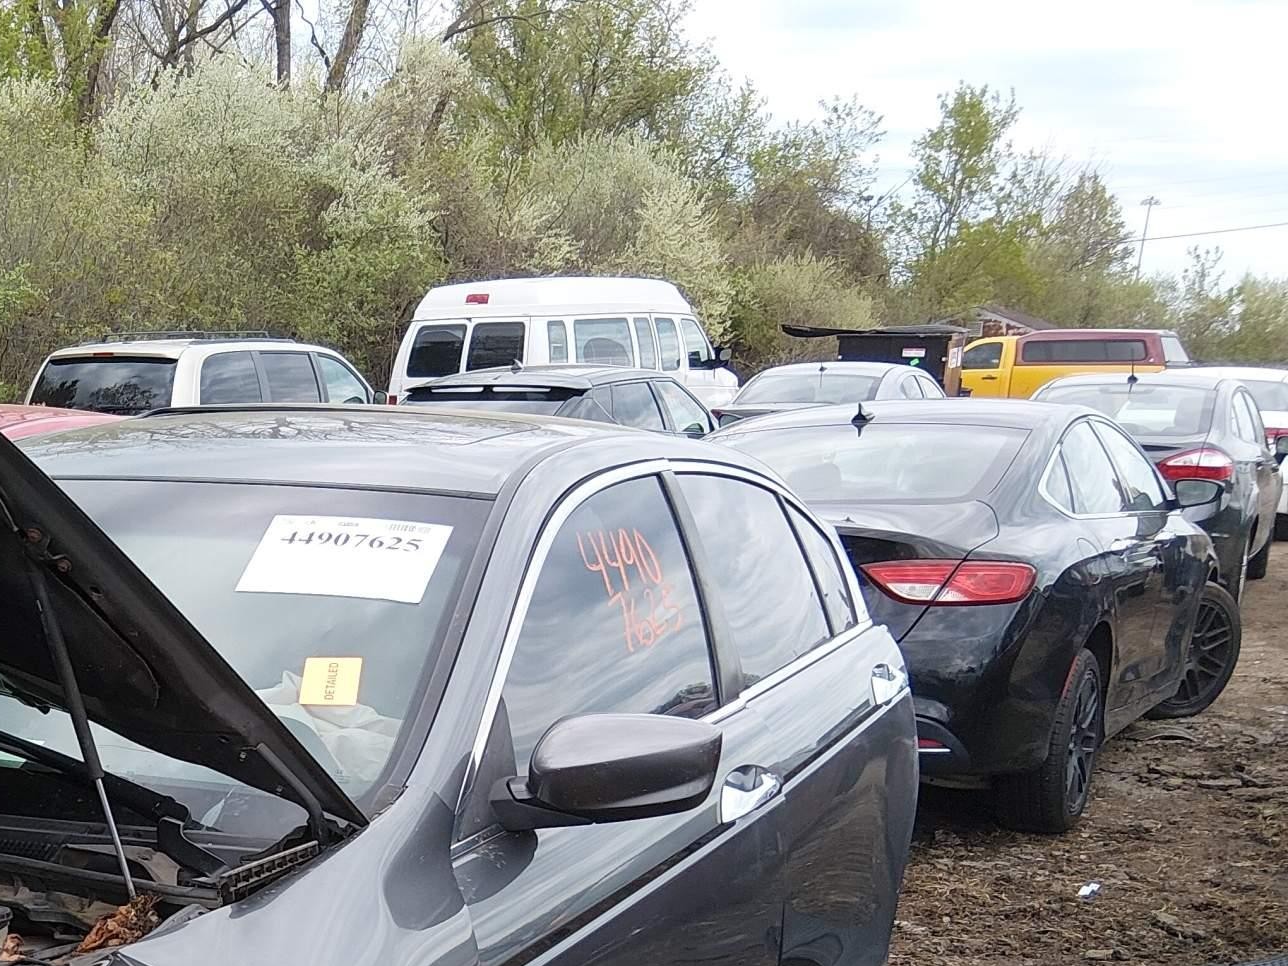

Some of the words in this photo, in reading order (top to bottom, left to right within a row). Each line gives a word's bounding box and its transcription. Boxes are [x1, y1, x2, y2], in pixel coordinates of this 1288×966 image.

[280, 530, 424, 552] 44907625
[576, 528, 664, 597] 4490
[323, 661, 340, 701] DETAILED
